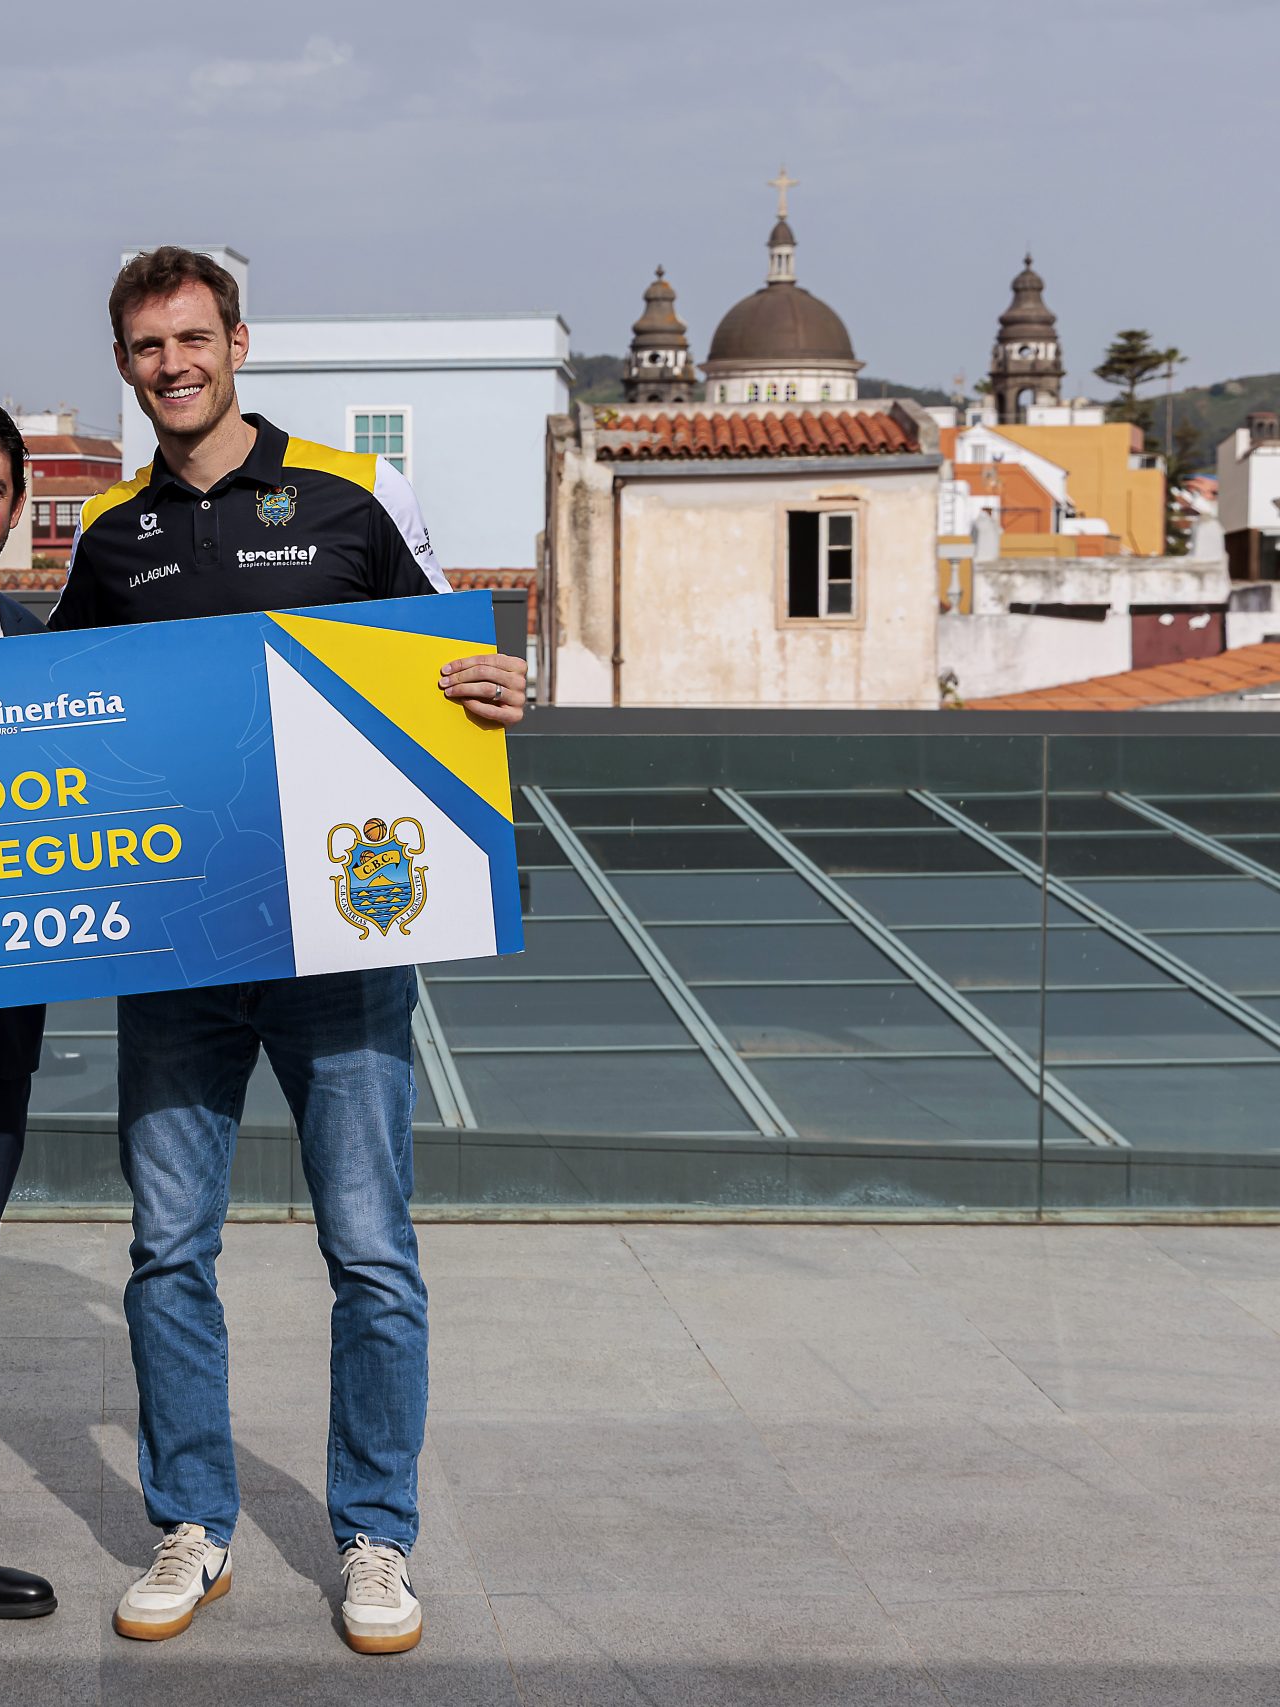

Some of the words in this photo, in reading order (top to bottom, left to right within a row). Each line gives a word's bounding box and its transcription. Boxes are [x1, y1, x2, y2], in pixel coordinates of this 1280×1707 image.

[129, 574, 141, 588] LA
[140, 562, 181, 583] LAGUNA
[362, 853, 394, 875] C.B.C.
[340, 898, 367, 926] CANARIAS
[405, 892, 422, 916] LAGUNA
